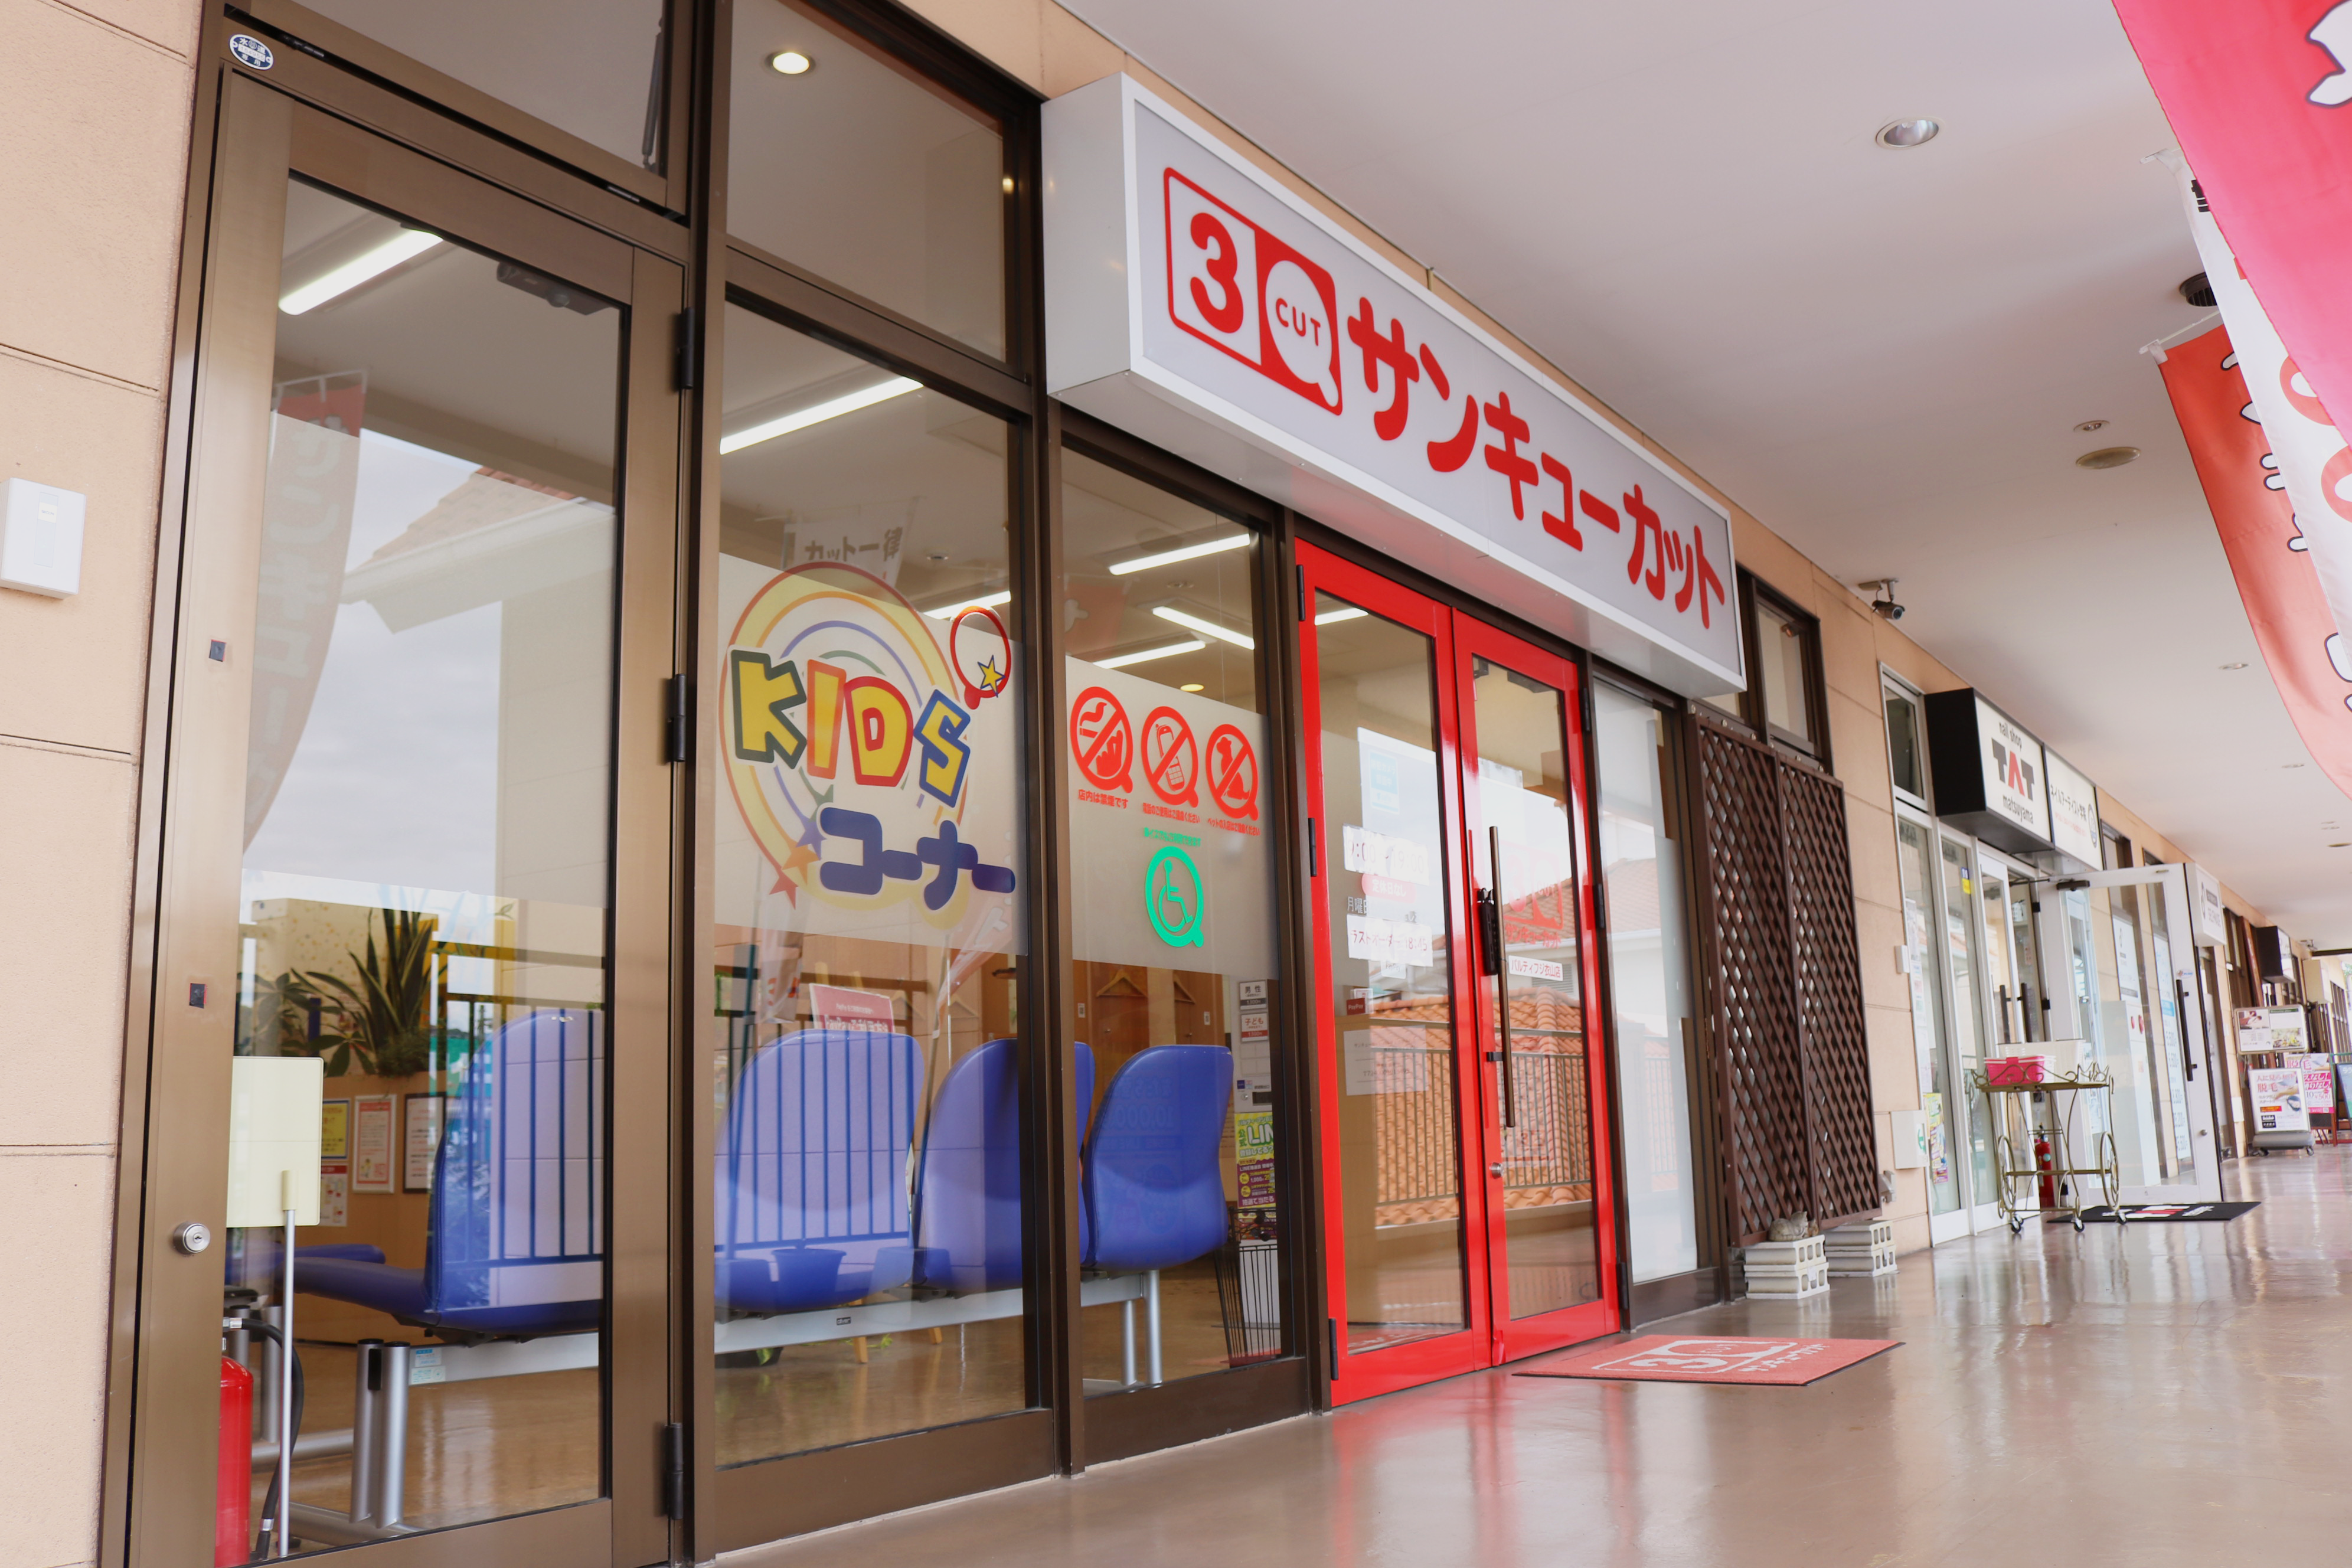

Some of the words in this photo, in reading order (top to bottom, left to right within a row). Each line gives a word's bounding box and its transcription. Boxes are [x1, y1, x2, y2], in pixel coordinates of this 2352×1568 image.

[1275, 297, 1321, 347] CUT
[1347, 295, 1725, 629] サンキューカット
[730, 647, 973, 808] KIDS
[1999, 722, 2008, 737] nail
[2010, 727, 2023, 752] shop
[1991, 737, 2035, 802] TAT
[1078, 789, 1128, 809] 店内は禁煙です
[2003, 794, 2034, 824] matsuyama
[819, 805, 1016, 912] コーナー
[1371, 879, 1406, 897] 定休日なし
[1350, 929, 1400, 948] ラストオーダー
[1405, 936, 1427, 952] 18:45
[1505, 922, 1562, 949] サンキューカット
[1244, 1017, 1263, 1026] 子ども
[2258, 1082, 2278, 1093] 脱毛
